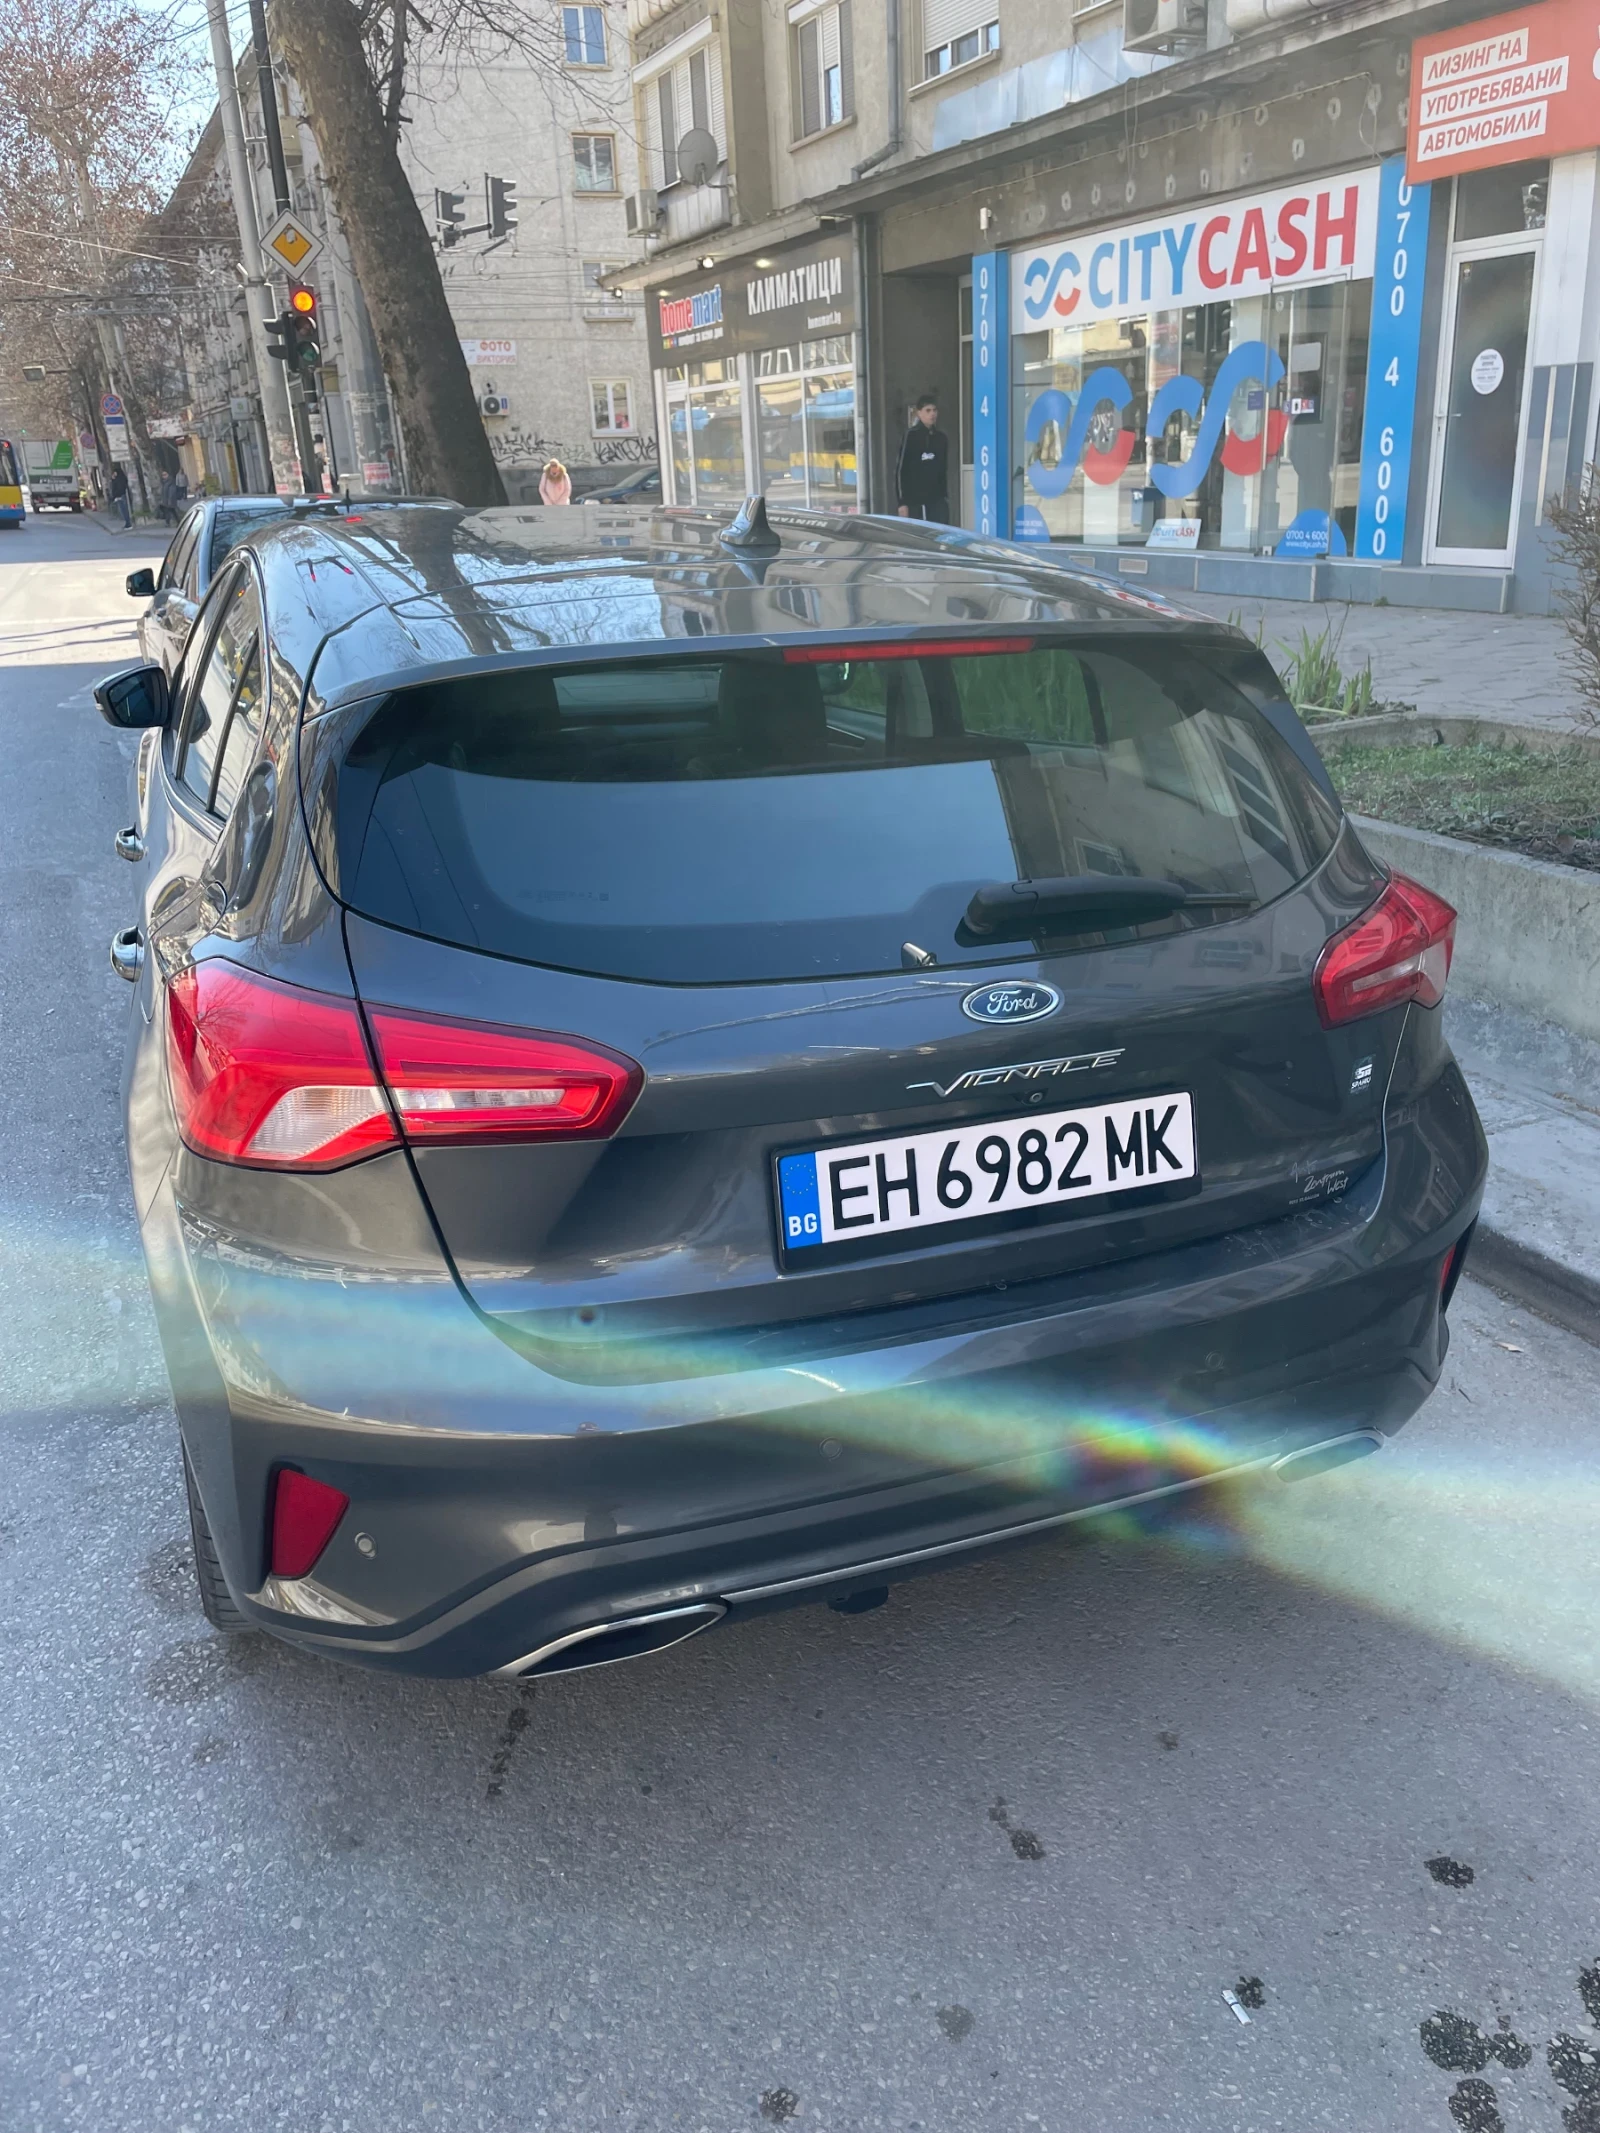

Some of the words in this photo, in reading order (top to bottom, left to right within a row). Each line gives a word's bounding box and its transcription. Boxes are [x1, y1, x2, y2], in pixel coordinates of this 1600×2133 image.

[1427, 44, 1496, 81] ЛИЗИНГ
[1498, 37, 1522, 61] НА
[1427, 65, 1563, 118] УПОТРЕБЯВАНИ
[1422, 108, 1541, 154] АВТОМОБИЛИ
[1089, 185, 1359, 309] CITYCASH
[1390, 175, 1413, 317] 0700
[747, 257, 842, 315] КЛИМАТИЦИ
[659, 283, 724, 337] homemart
[980, 267, 988, 367] 0700
[480, 340, 511, 352] ФОТО
[1384, 356, 1399, 387] 4
[980, 395, 989, 417] 4
[1373, 426, 1394, 556] 6000
[1286, 530, 1304, 540] 0700
[1305, 532, 1310, 540] 4
[986, 988, 1038, 1015] Ford
[906, 1049, 1126, 1098] VIGNALE
[829, 1148, 920, 1231] EH
[936, 1121, 1092, 1209] 6982
[1105, 1104, 1183, 1182] MK
[1303, 1170, 1345, 1193] Zentrum
[1326, 1176, 1349, 1195] West
[788, 1212, 818, 1238] BG
